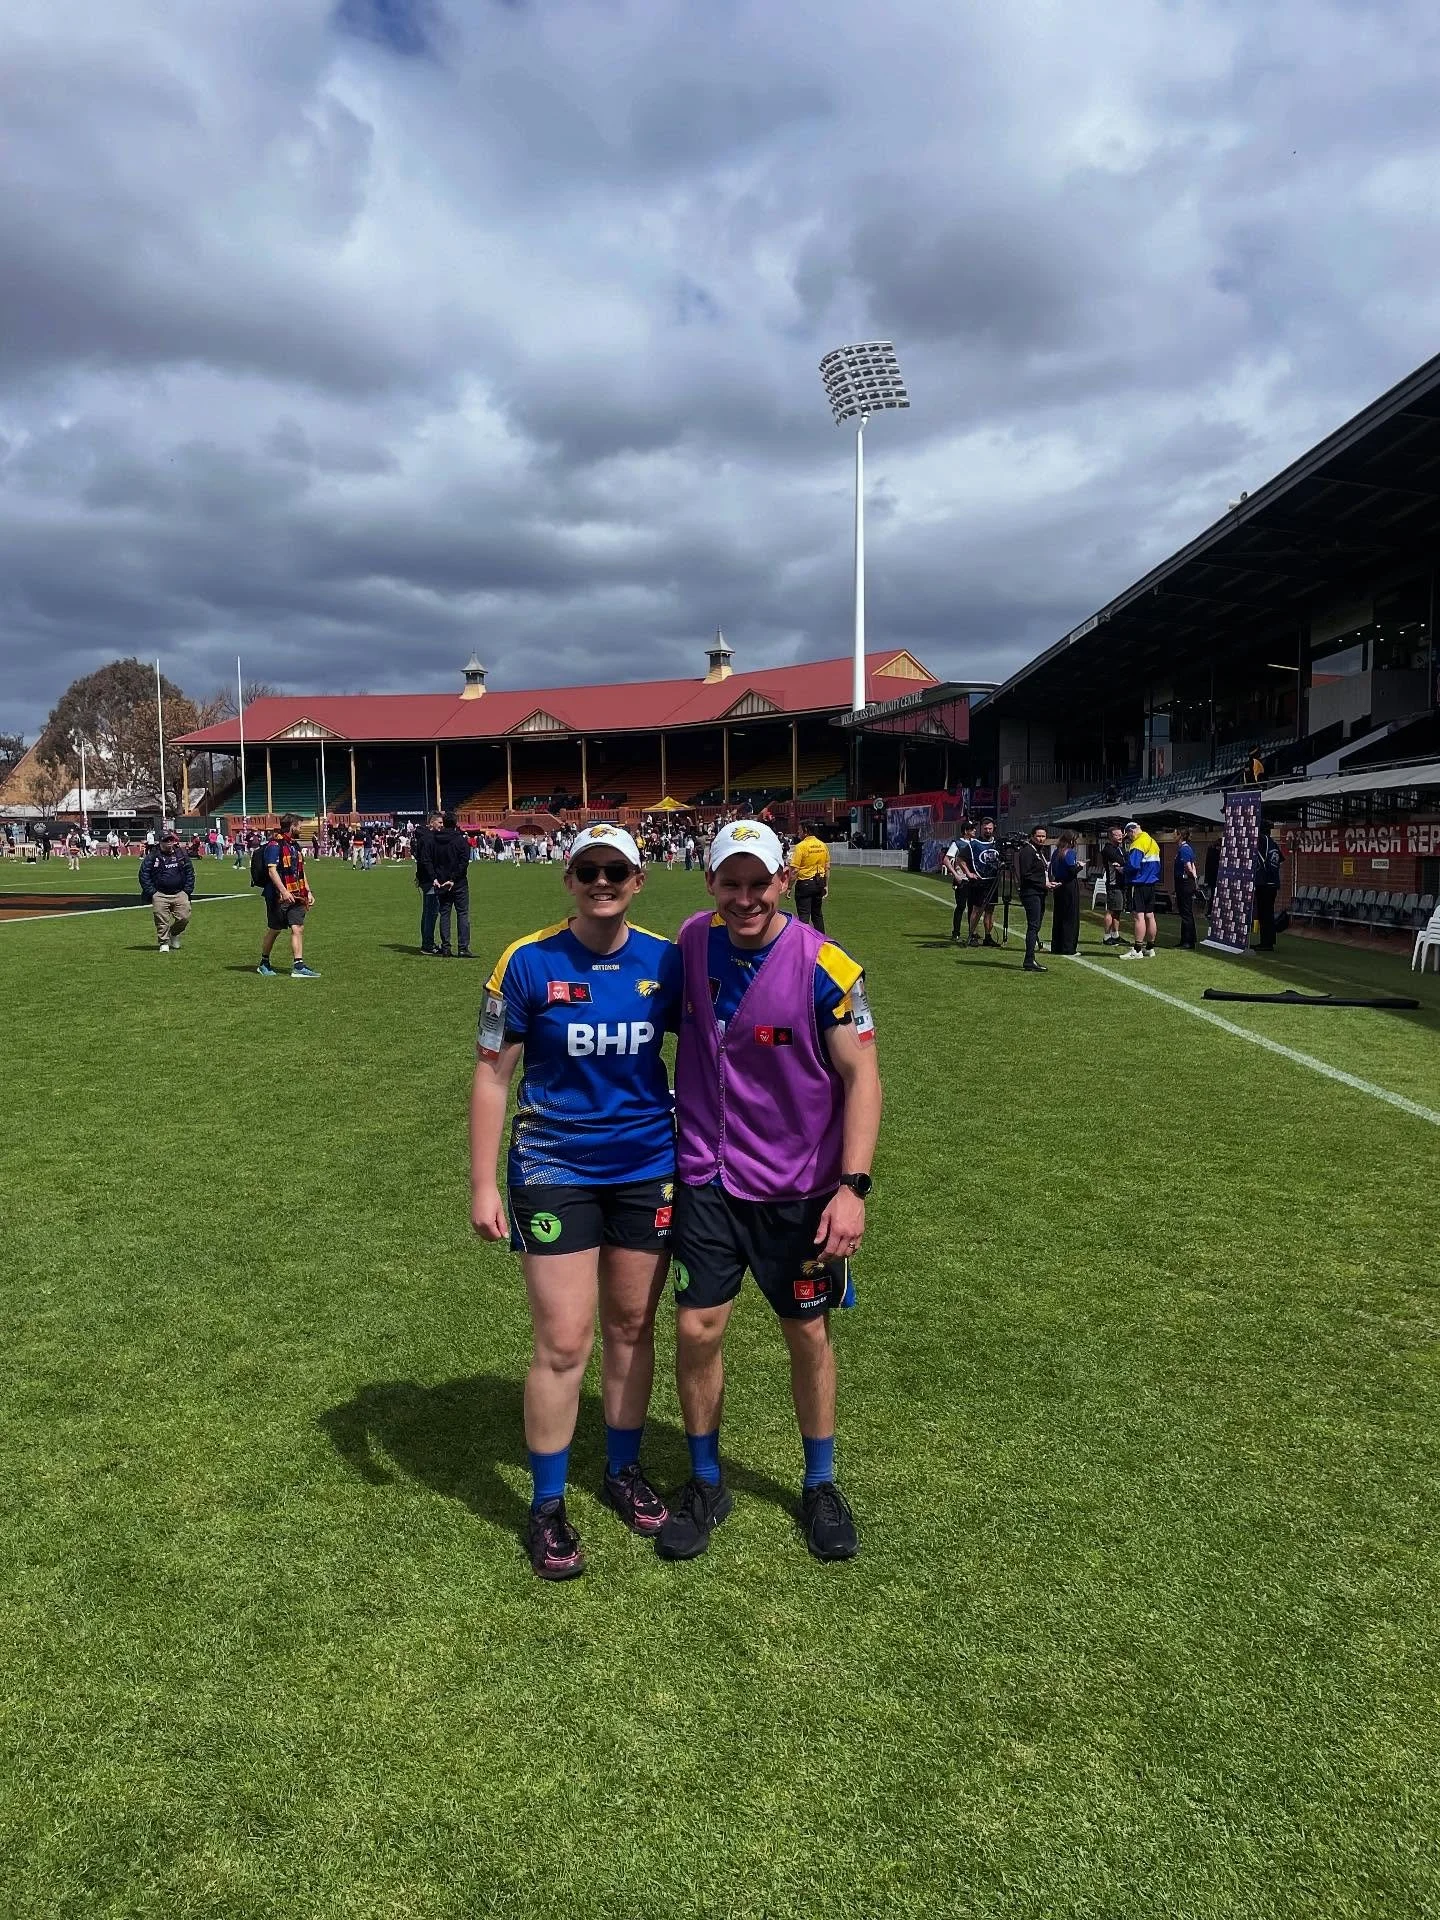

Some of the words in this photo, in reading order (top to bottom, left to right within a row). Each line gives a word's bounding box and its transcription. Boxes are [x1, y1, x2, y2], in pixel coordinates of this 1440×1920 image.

[841, 712, 854, 726] WOLF
[869, 697, 900, 718] COMMUNITY
[901, 691, 923, 708] CENTRE
[1344, 826, 1401, 853] CRASH
[567, 1021, 655, 1057] BHP
